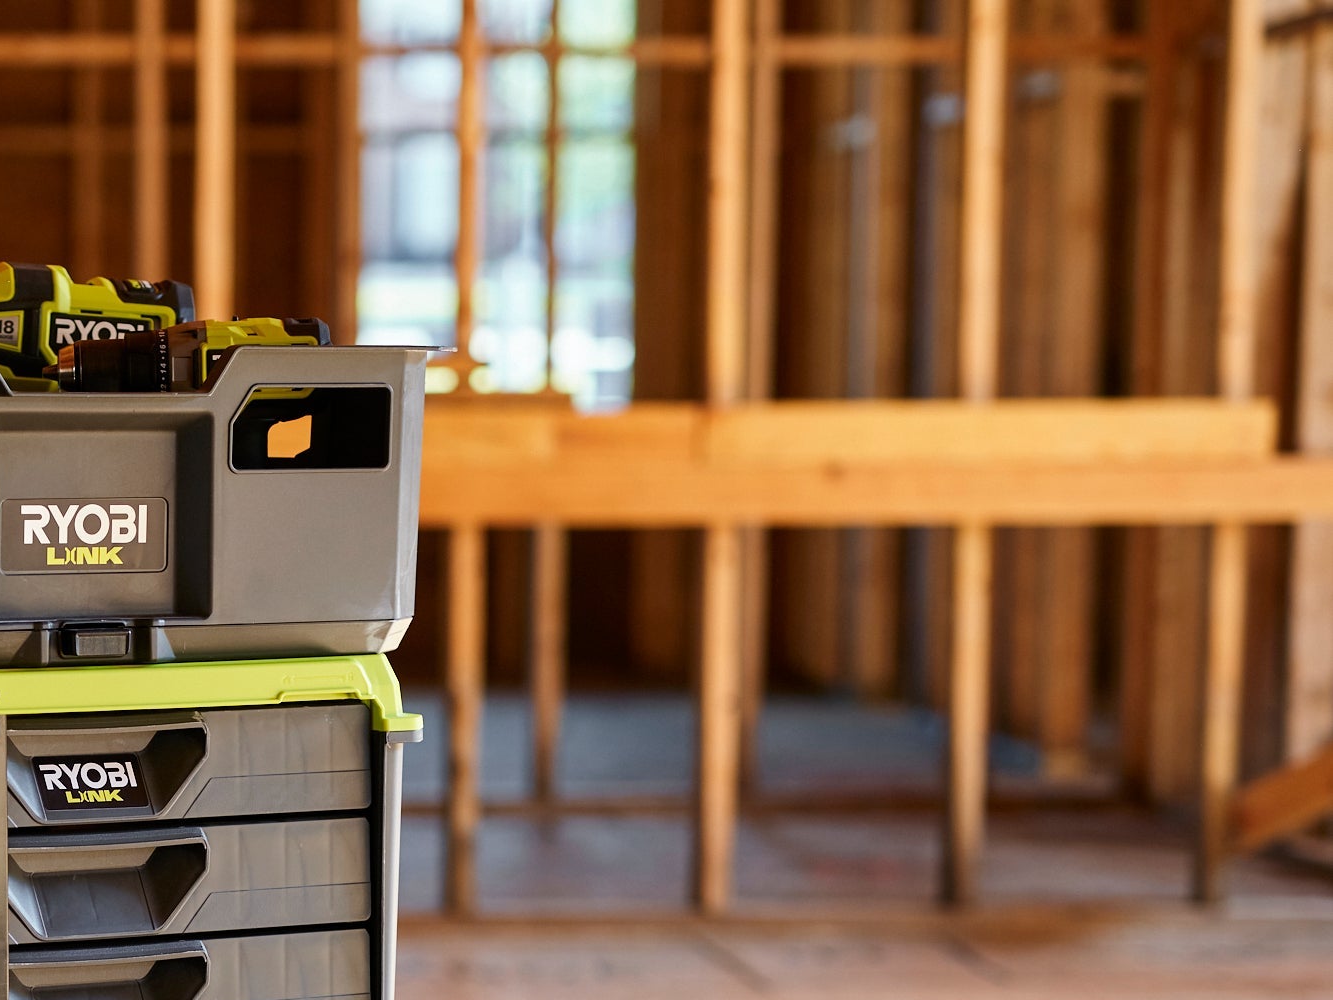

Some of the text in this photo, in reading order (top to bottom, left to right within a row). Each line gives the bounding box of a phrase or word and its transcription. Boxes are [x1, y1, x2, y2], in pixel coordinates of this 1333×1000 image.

[55, 318, 145, 345] RYO
[20, 504, 148, 544] RYOBI
[46, 546, 124, 566] LINK
[38, 761, 138, 790] RYOBI
